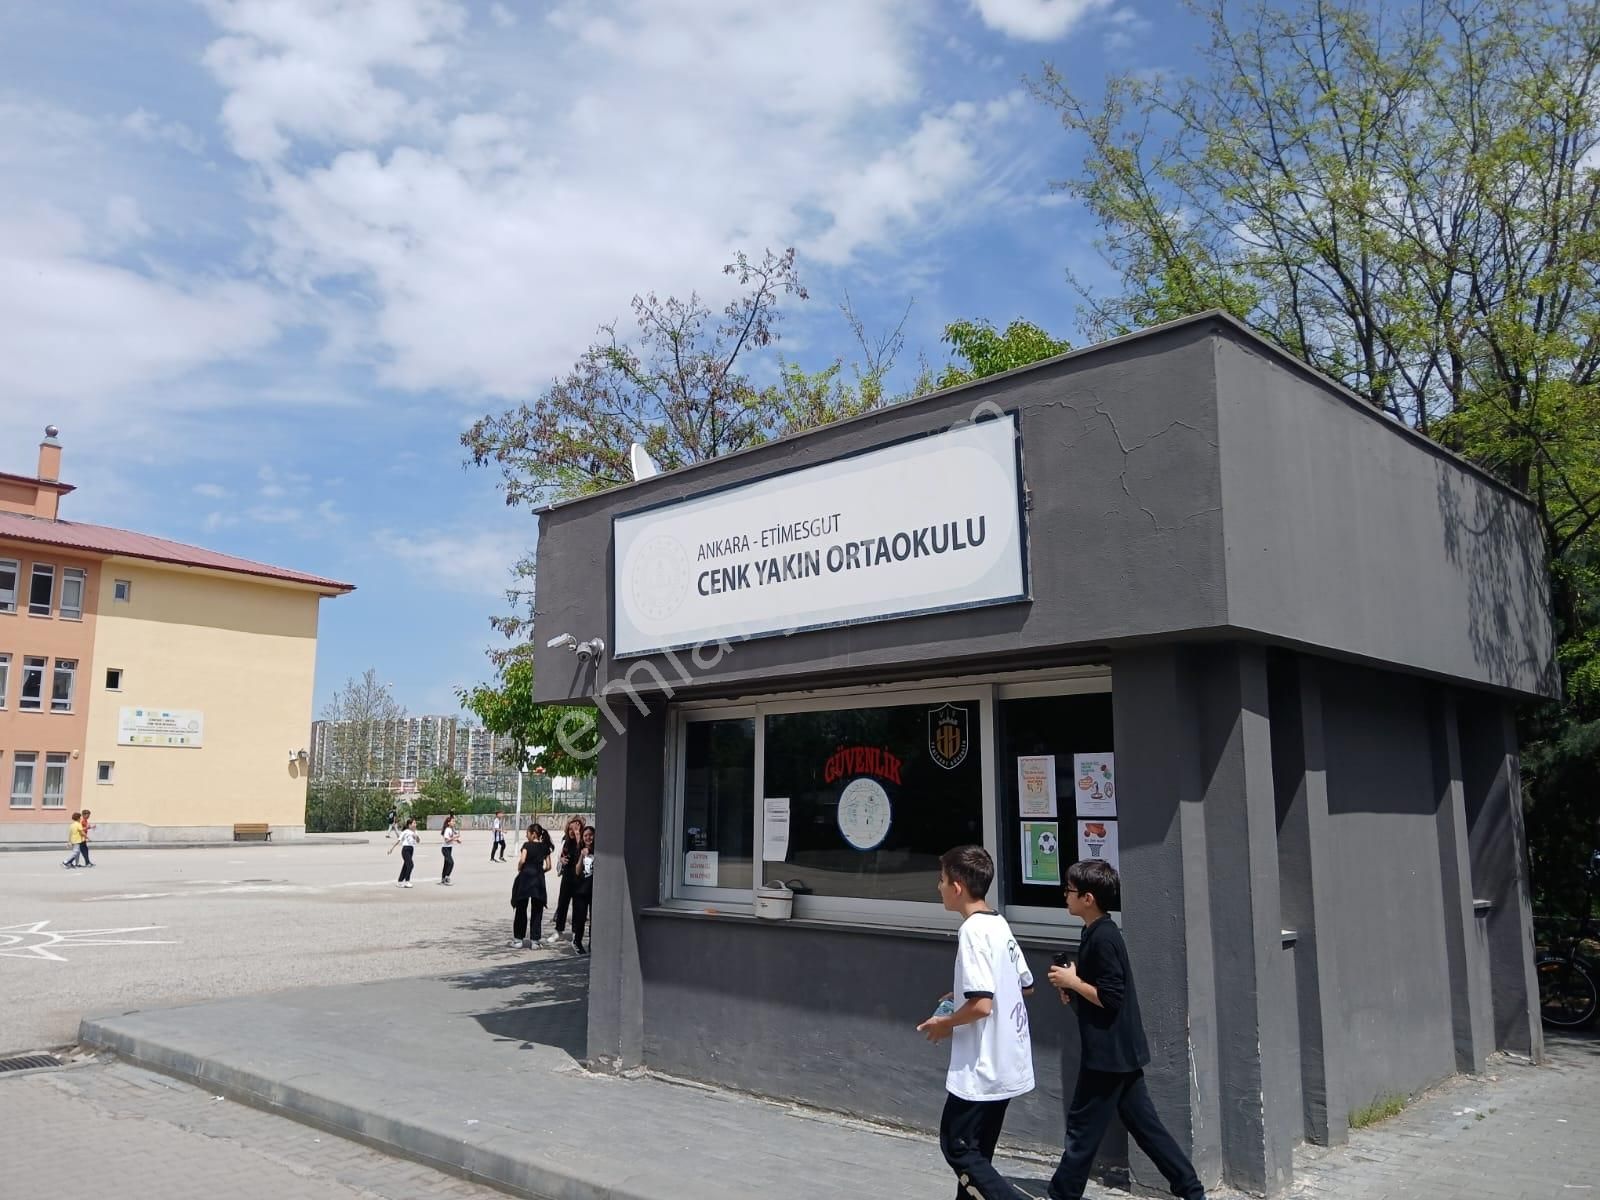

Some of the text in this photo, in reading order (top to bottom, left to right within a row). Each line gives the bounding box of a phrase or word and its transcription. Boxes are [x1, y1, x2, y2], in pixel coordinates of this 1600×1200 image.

[697, 534, 750, 562] ANKARA
[761, 513, 841, 548] ETİMESGUT
[697, 515, 986, 597] CENK YAKIN ORTAOKULU
[824, 746, 902, 785] GÜVENLİK
